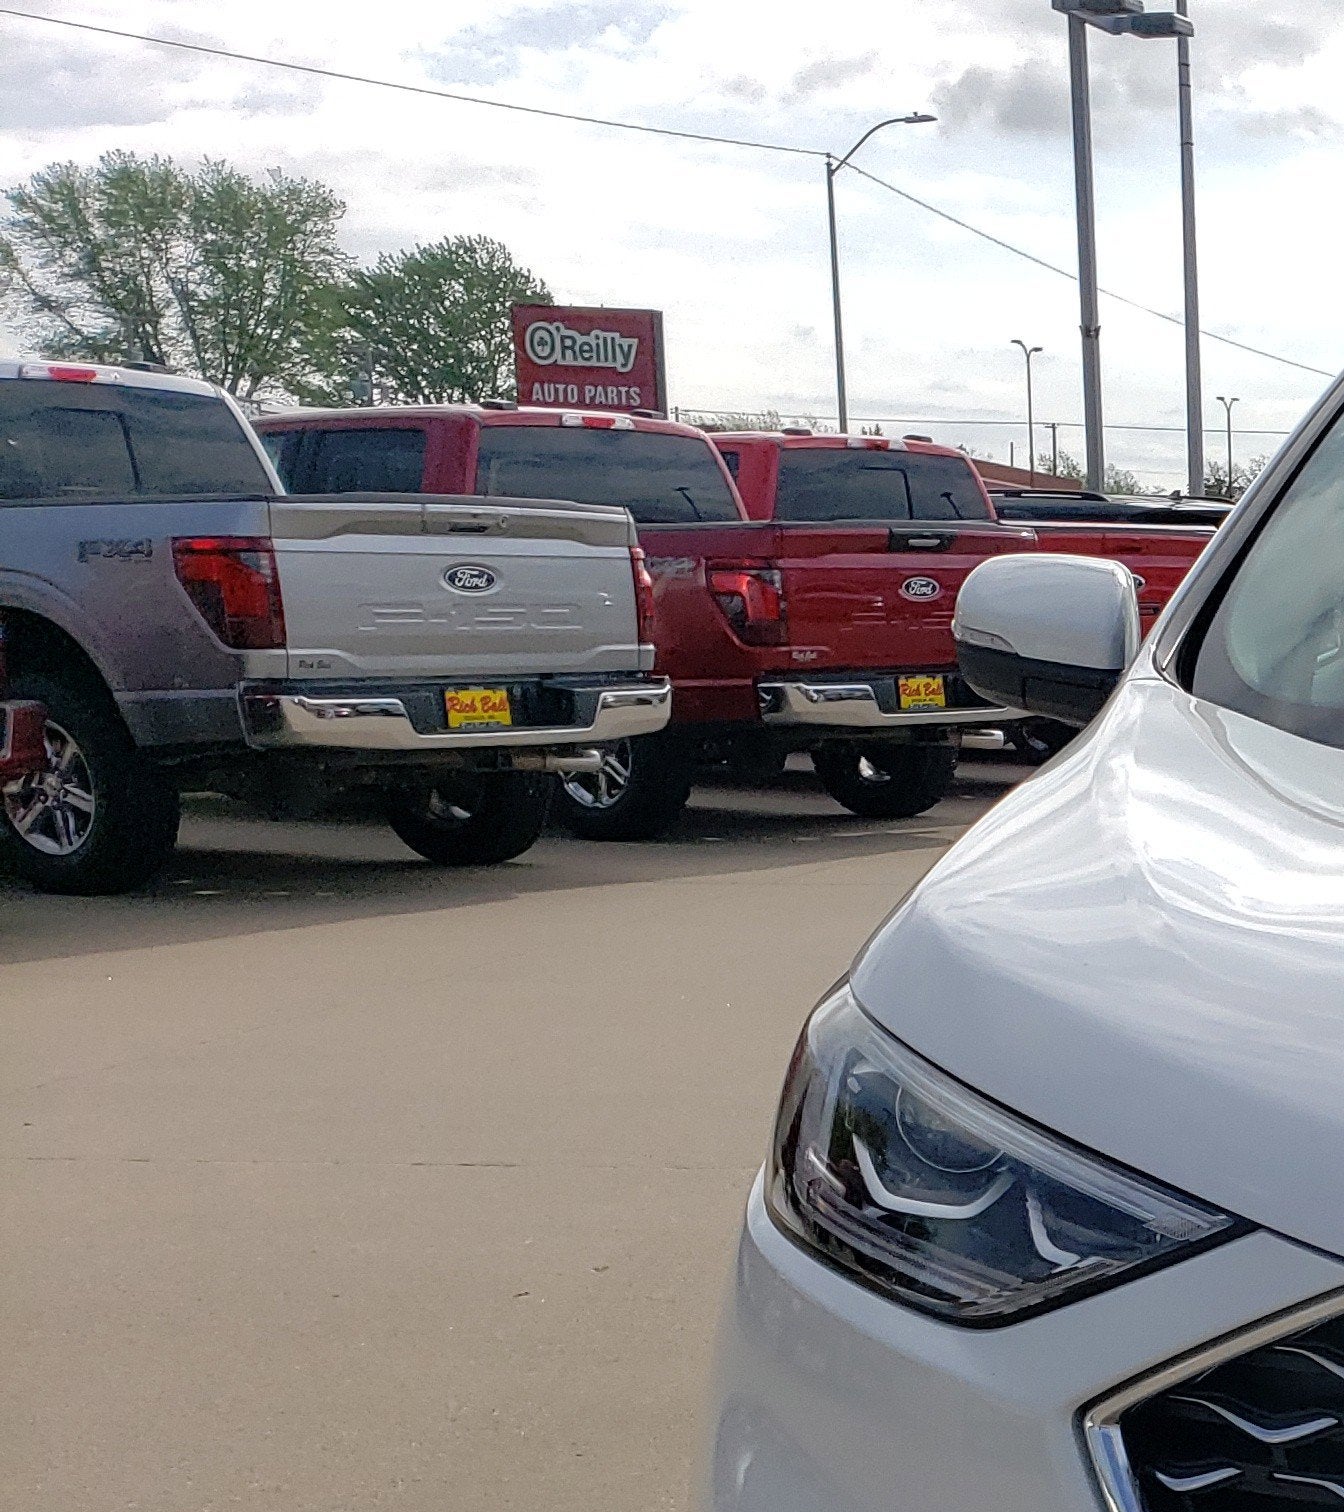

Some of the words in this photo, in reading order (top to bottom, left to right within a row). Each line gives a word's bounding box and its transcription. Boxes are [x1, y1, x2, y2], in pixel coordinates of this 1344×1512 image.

[529, 324, 634, 370] O'Reilly
[532, 381, 578, 404] AUTO
[584, 384, 642, 406] PARTS
[454, 569, 489, 588] Ford
[908, 580, 934, 595] Ford
